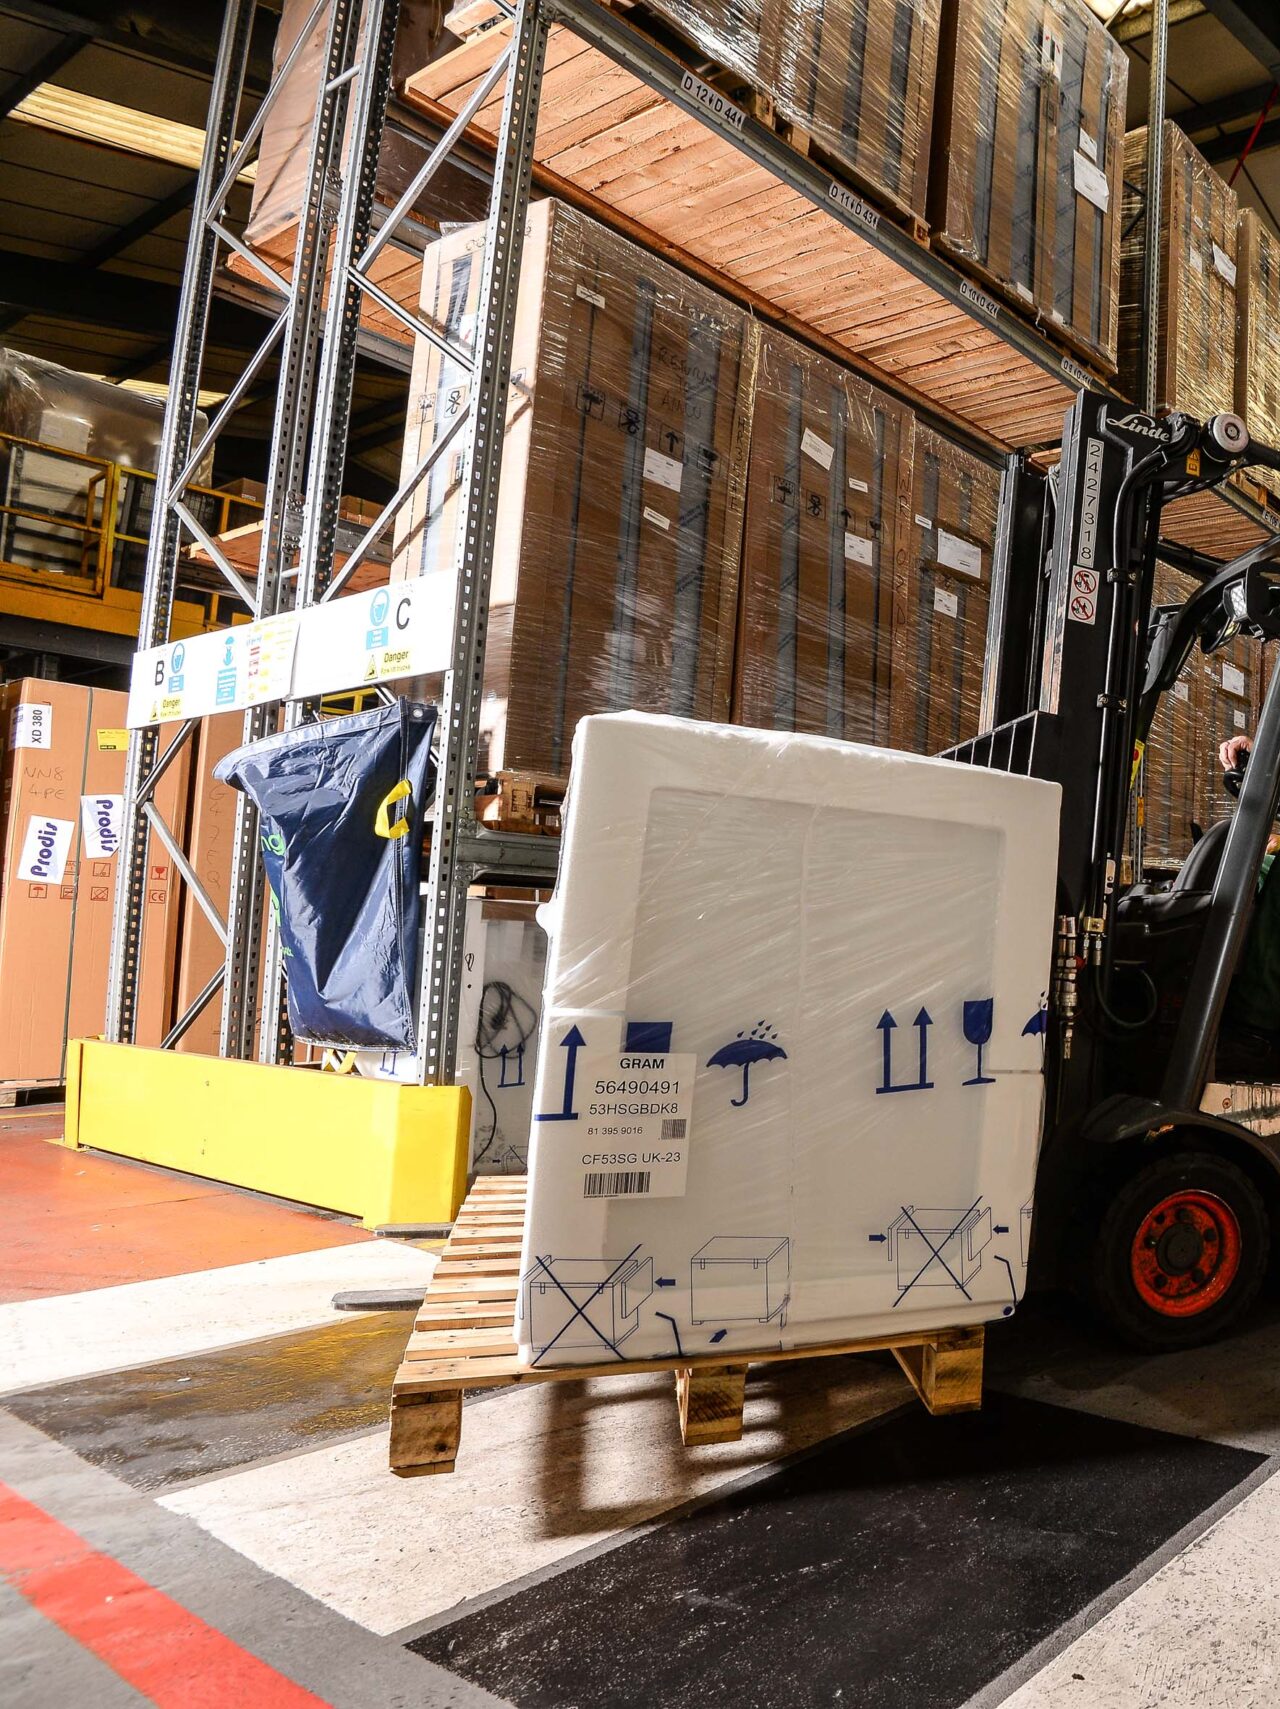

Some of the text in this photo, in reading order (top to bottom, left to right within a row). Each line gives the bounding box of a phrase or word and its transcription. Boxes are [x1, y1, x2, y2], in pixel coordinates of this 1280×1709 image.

[684, 76, 708, 103] D 12
[714, 98, 738, 124] D 44
[830, 184, 850, 208] D 11
[854, 202, 862, 215] D
[1106, 413, 1171, 443] Linde
[396, 597, 412, 630] C
[154, 660, 165, 686] B
[32, 709, 43, 744] XD 380
[96, 799, 118, 852] Prodis
[30, 822, 58, 877] Prodis
[620, 1058, 664, 1070] GRAM
[594, 1080, 680, 1095] 56490491
[589, 1103, 678, 1116] 53HSGBDK8
[587, 1126, 644, 1135] 81 395 9016
[581, 1152, 681, 1166] CF53SG UK-23
